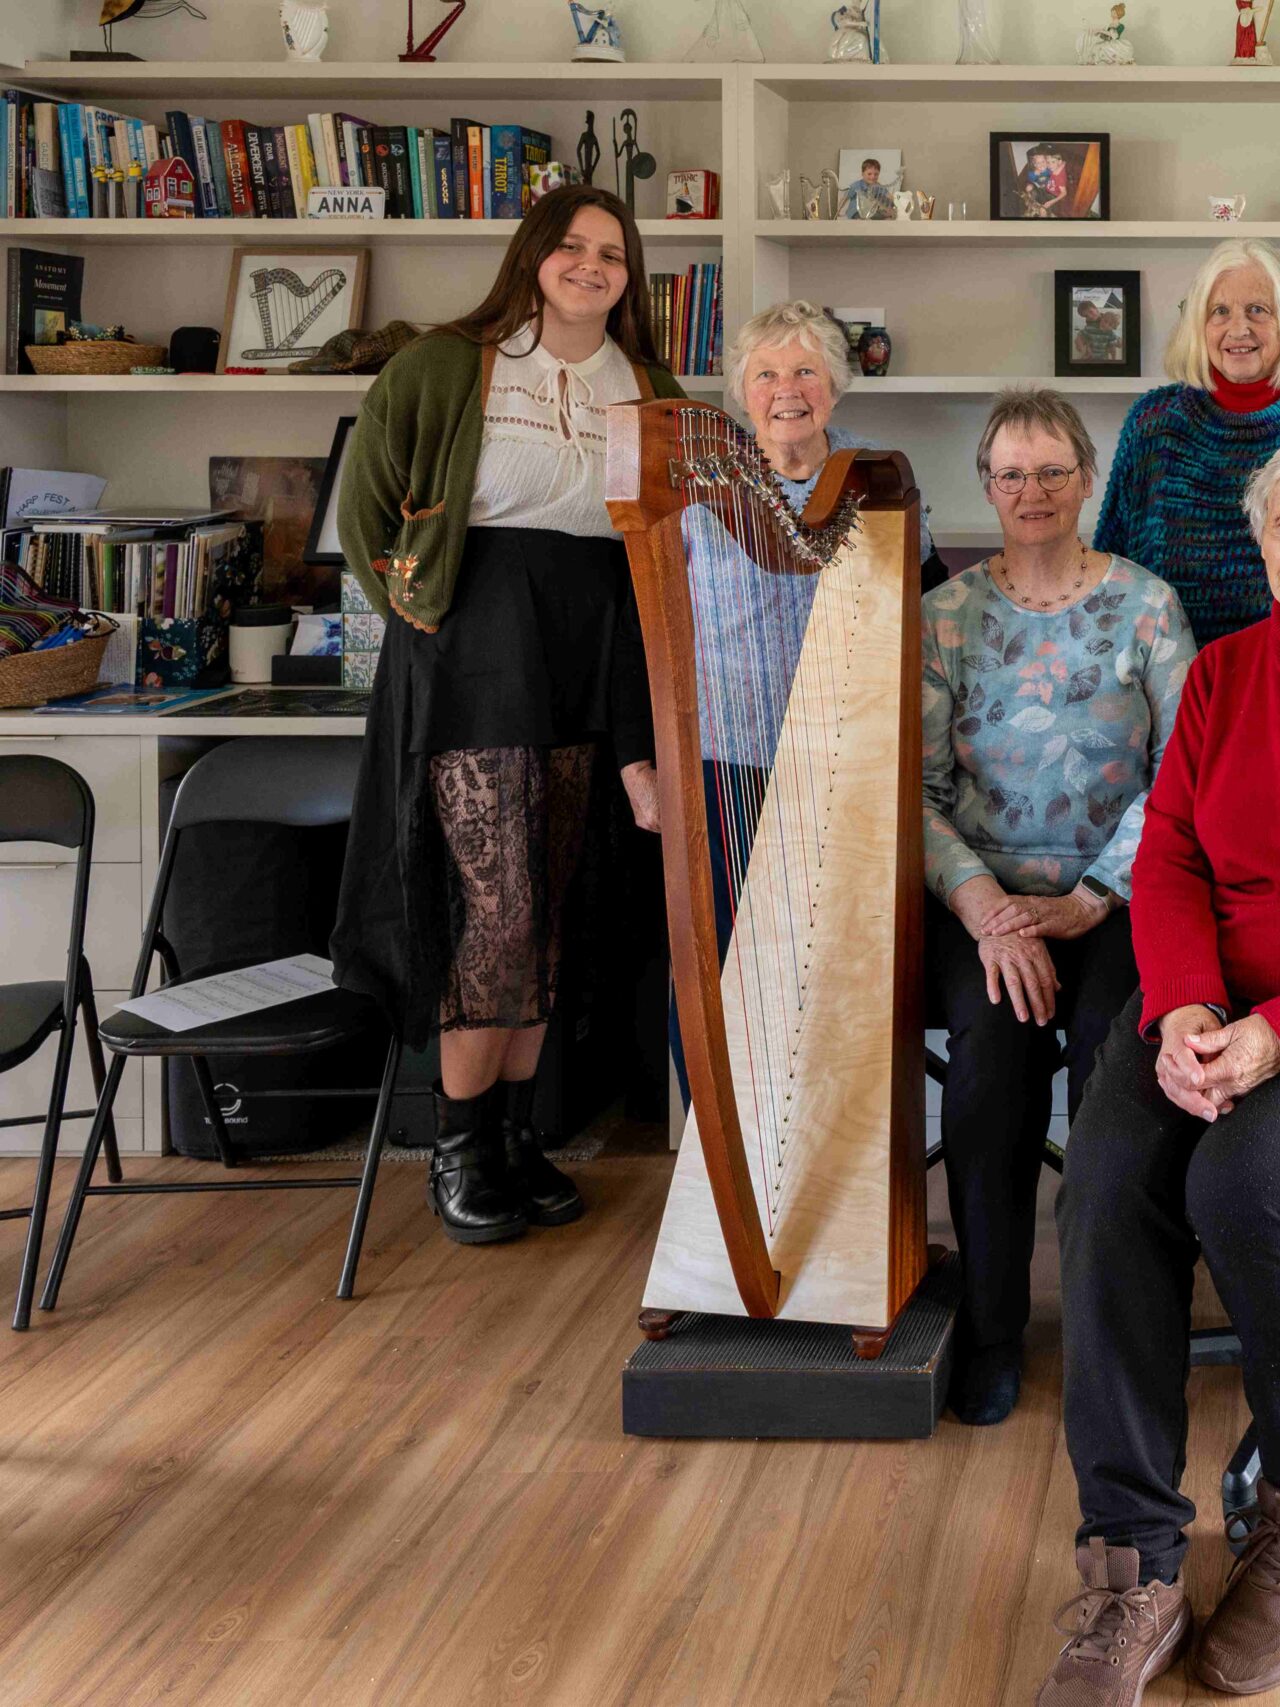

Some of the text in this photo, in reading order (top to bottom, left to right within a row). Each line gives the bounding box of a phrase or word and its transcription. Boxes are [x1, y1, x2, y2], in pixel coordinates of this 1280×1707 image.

[247, 132, 265, 185] DIVERGENT
[265, 142, 274, 161] FOUR
[227, 142, 245, 205] ALLEGIANT
[495, 157, 508, 193] TAROT
[673, 173, 698, 184] TITANIC
[318, 197, 373, 213] ANNA
[33, 278, 67, 292] Movement
[16, 495, 38, 516] HARP
[44, 493, 71, 507] FEST
